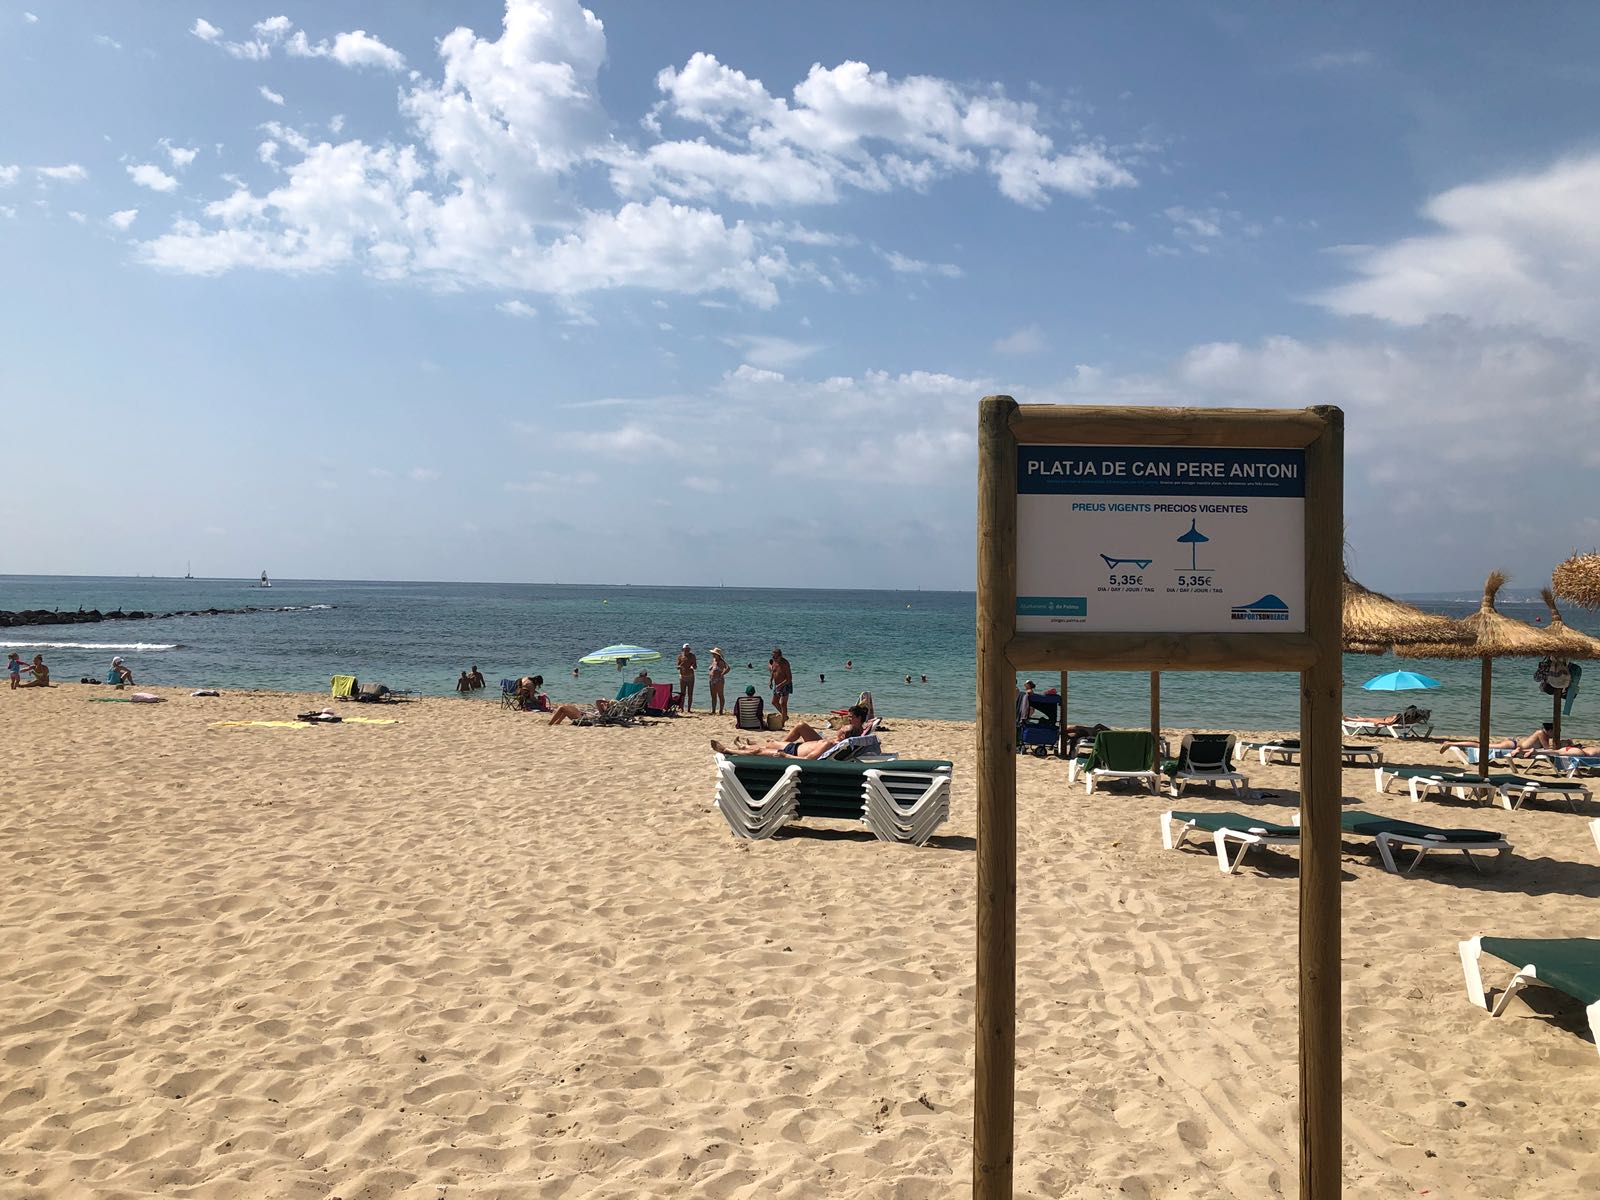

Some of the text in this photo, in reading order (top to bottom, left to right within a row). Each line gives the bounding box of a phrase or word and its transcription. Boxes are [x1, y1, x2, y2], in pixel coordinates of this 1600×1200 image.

[1027, 461, 1298, 479] PLATJA DE CAN PERE ANTONI
[1072, 503, 1248, 514] PREUS VIGENTS PRECIOS VIGENTES
[1109, 575, 1144, 586] 5,35€
[1178, 575, 1212, 587] 5,35€
